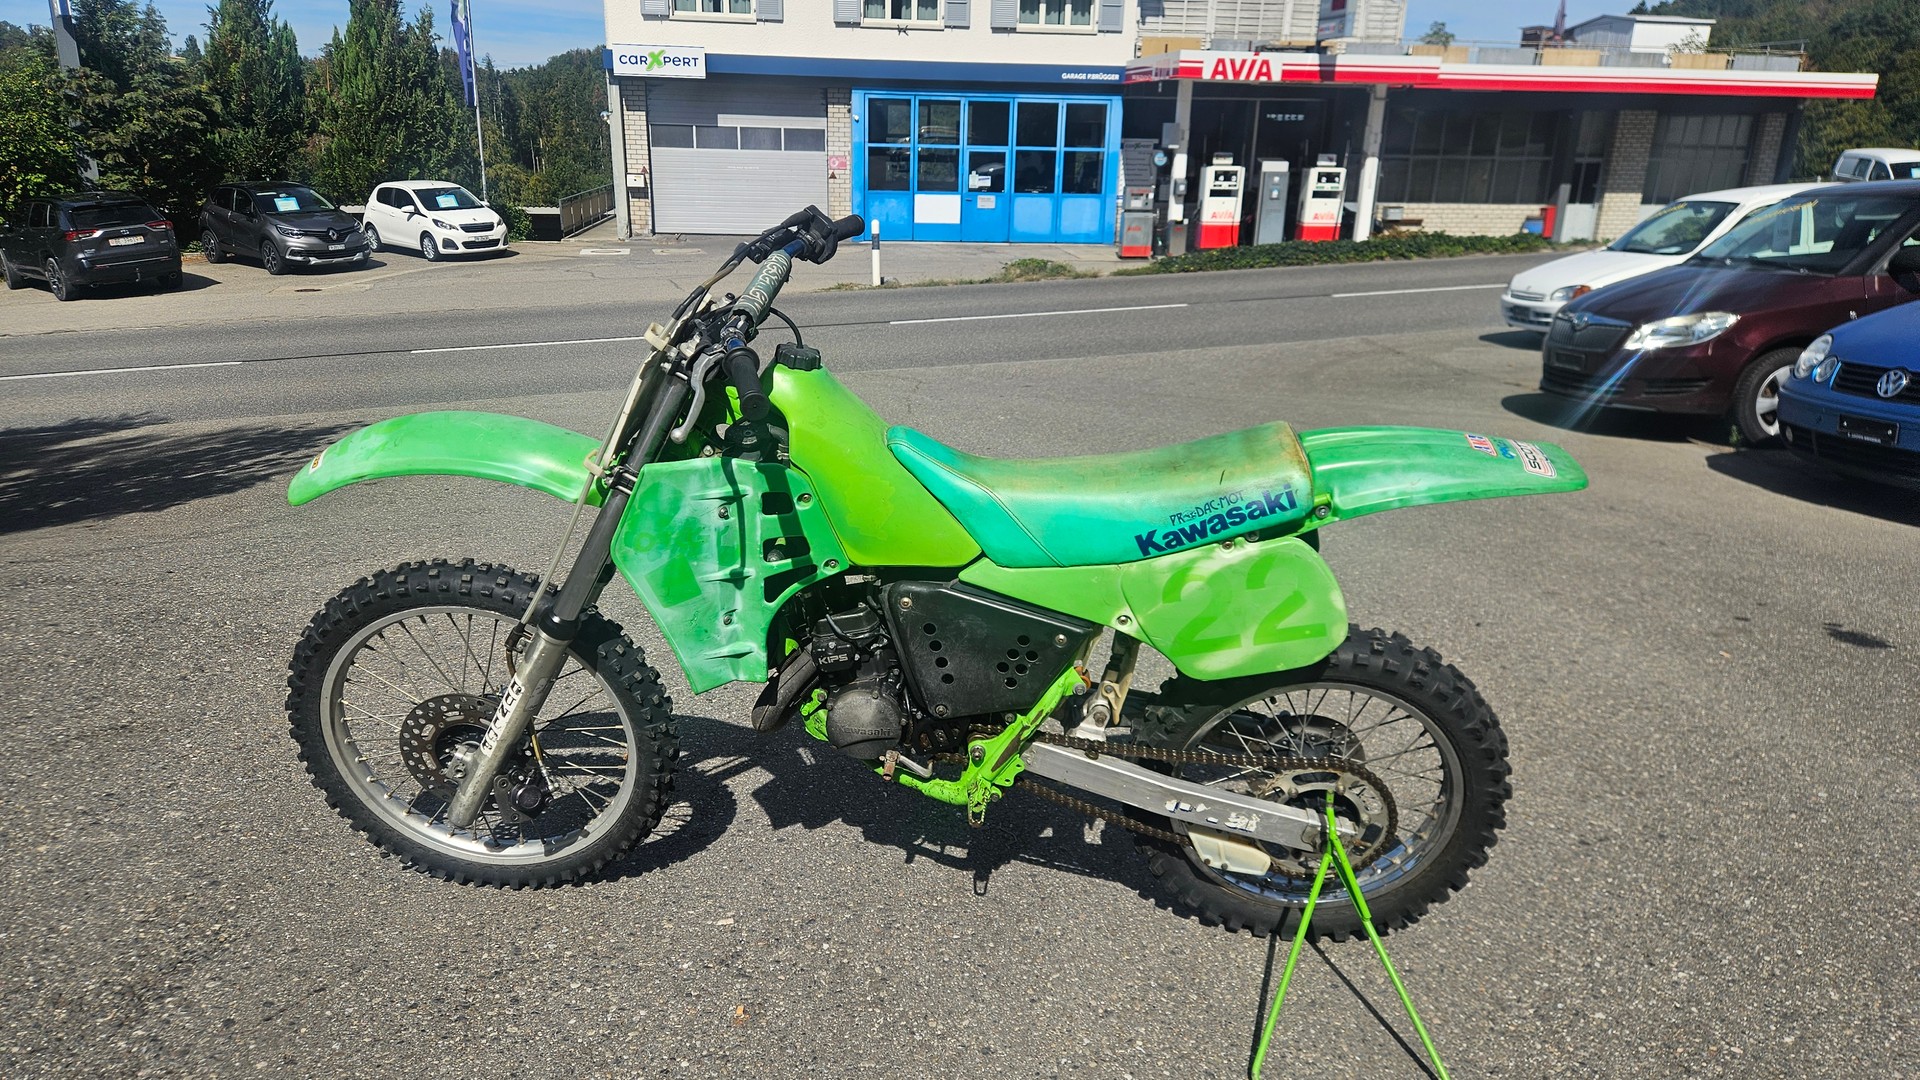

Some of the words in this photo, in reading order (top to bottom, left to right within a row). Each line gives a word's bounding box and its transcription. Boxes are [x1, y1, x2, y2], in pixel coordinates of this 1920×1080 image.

[1061, 72, 1087, 80] GARAGE
[1210, 52, 1272, 81] AVIA
[1134, 483, 1298, 557] Kawasaki
[818, 653, 849, 665] KIPS
